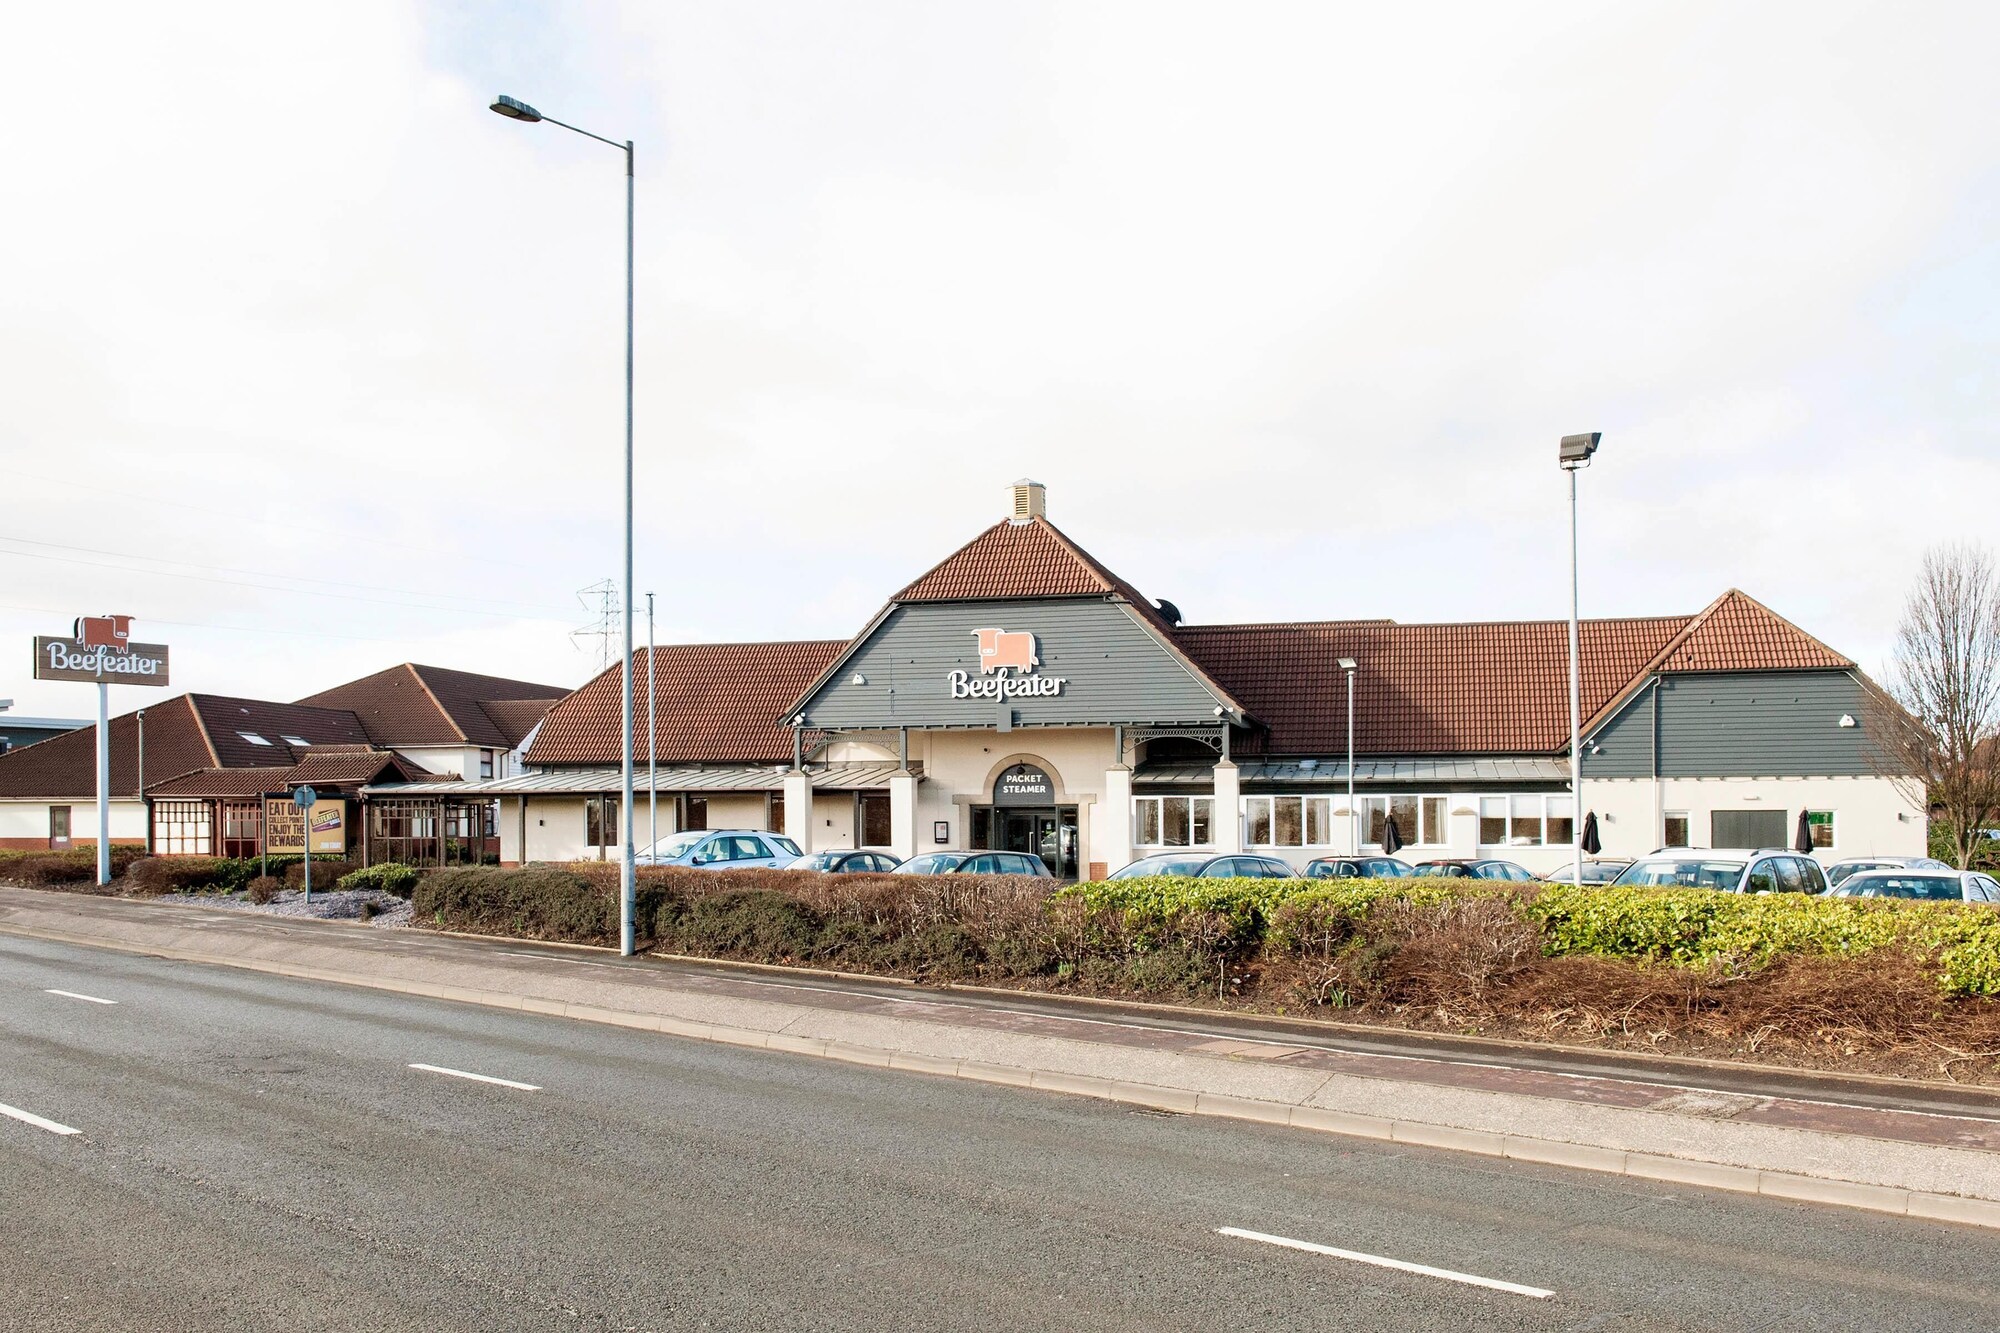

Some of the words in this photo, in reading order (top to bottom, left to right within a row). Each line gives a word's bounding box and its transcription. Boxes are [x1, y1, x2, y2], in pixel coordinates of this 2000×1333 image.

[46, 642, 162, 677] Beefeater
[947, 667, 1066, 702] Beefeater
[1006, 774, 1042, 783] PACKET
[1003, 785, 1046, 793] STEAMER
[269, 802, 286, 816] EAT
[269, 816, 288, 824] COLLECT
[269, 824, 291, 835] ENJOY
[293, 824, 305, 835] THE
[269, 835, 305, 847] REWARDS
